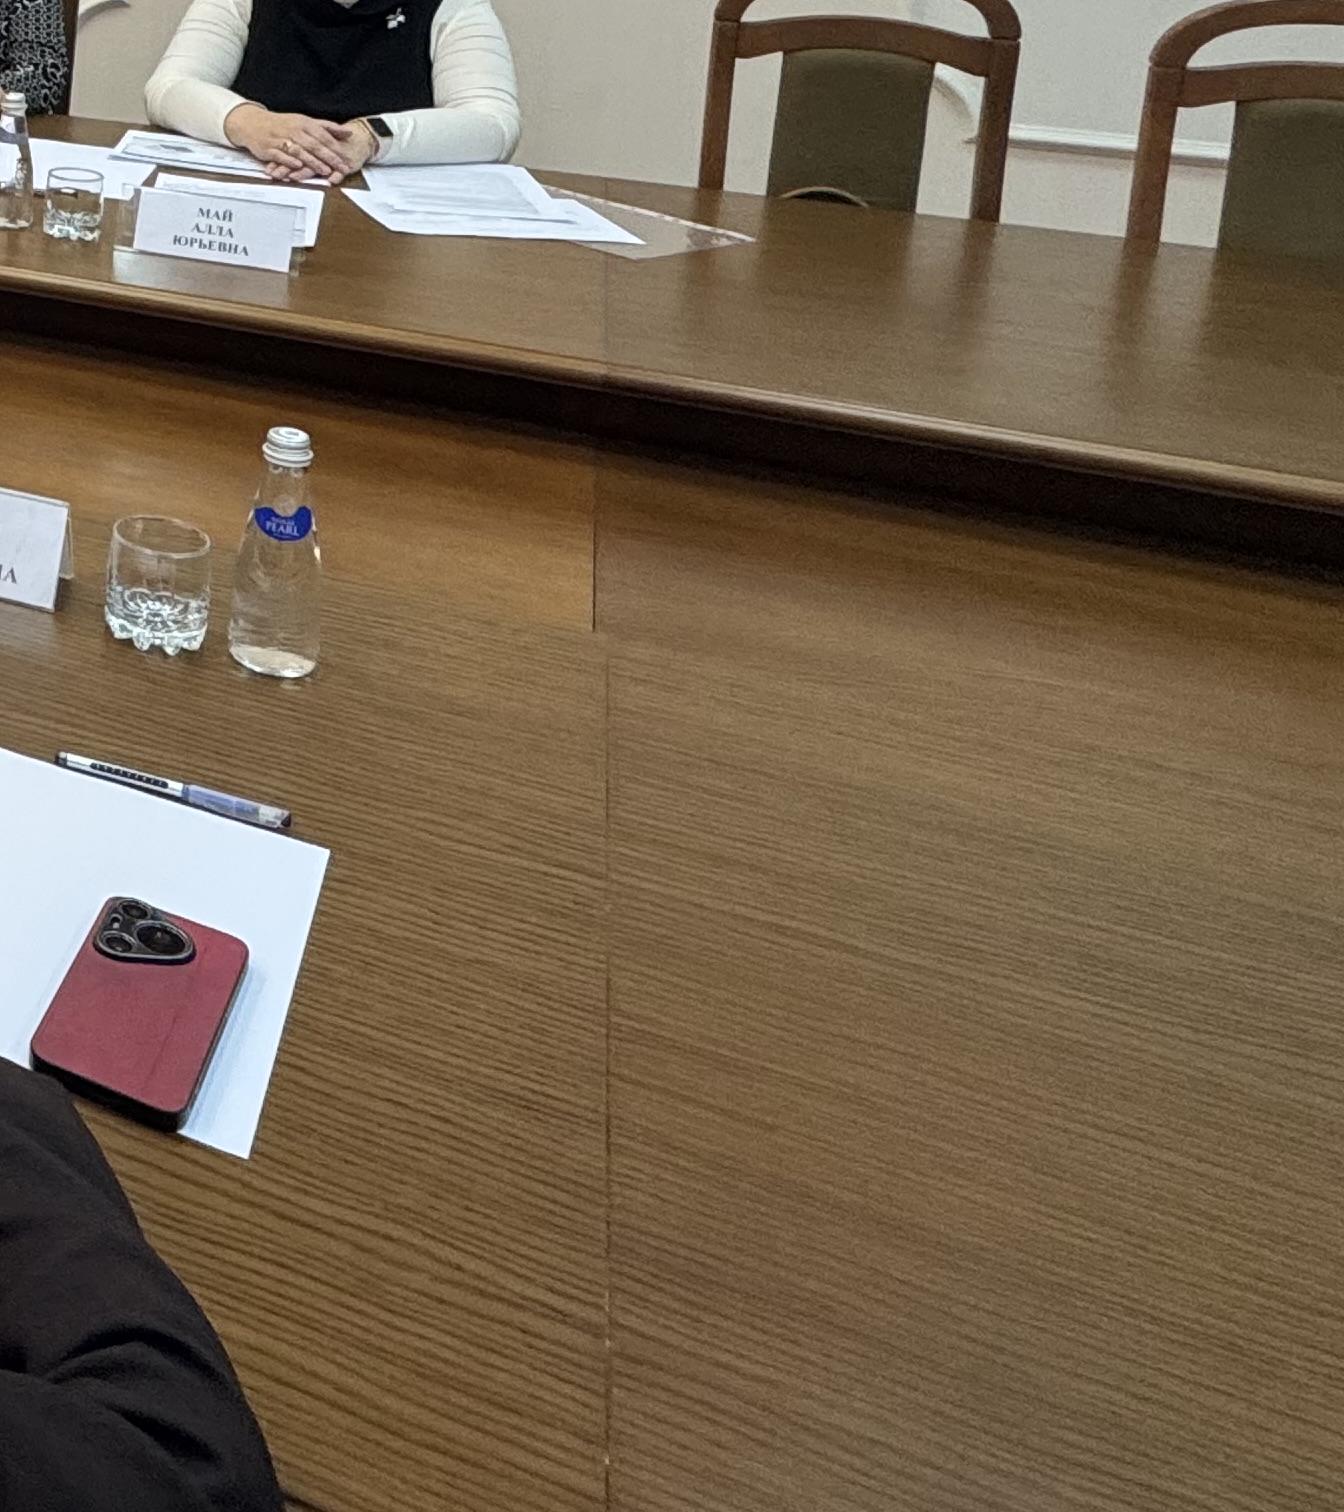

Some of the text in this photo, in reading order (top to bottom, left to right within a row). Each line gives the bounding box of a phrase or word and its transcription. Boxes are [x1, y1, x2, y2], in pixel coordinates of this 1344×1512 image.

[196, 207, 234, 222] МАЙ
[191, 222, 234, 238] АЛЛА
[172, 234, 249, 256] ЮРЬЕВНА
